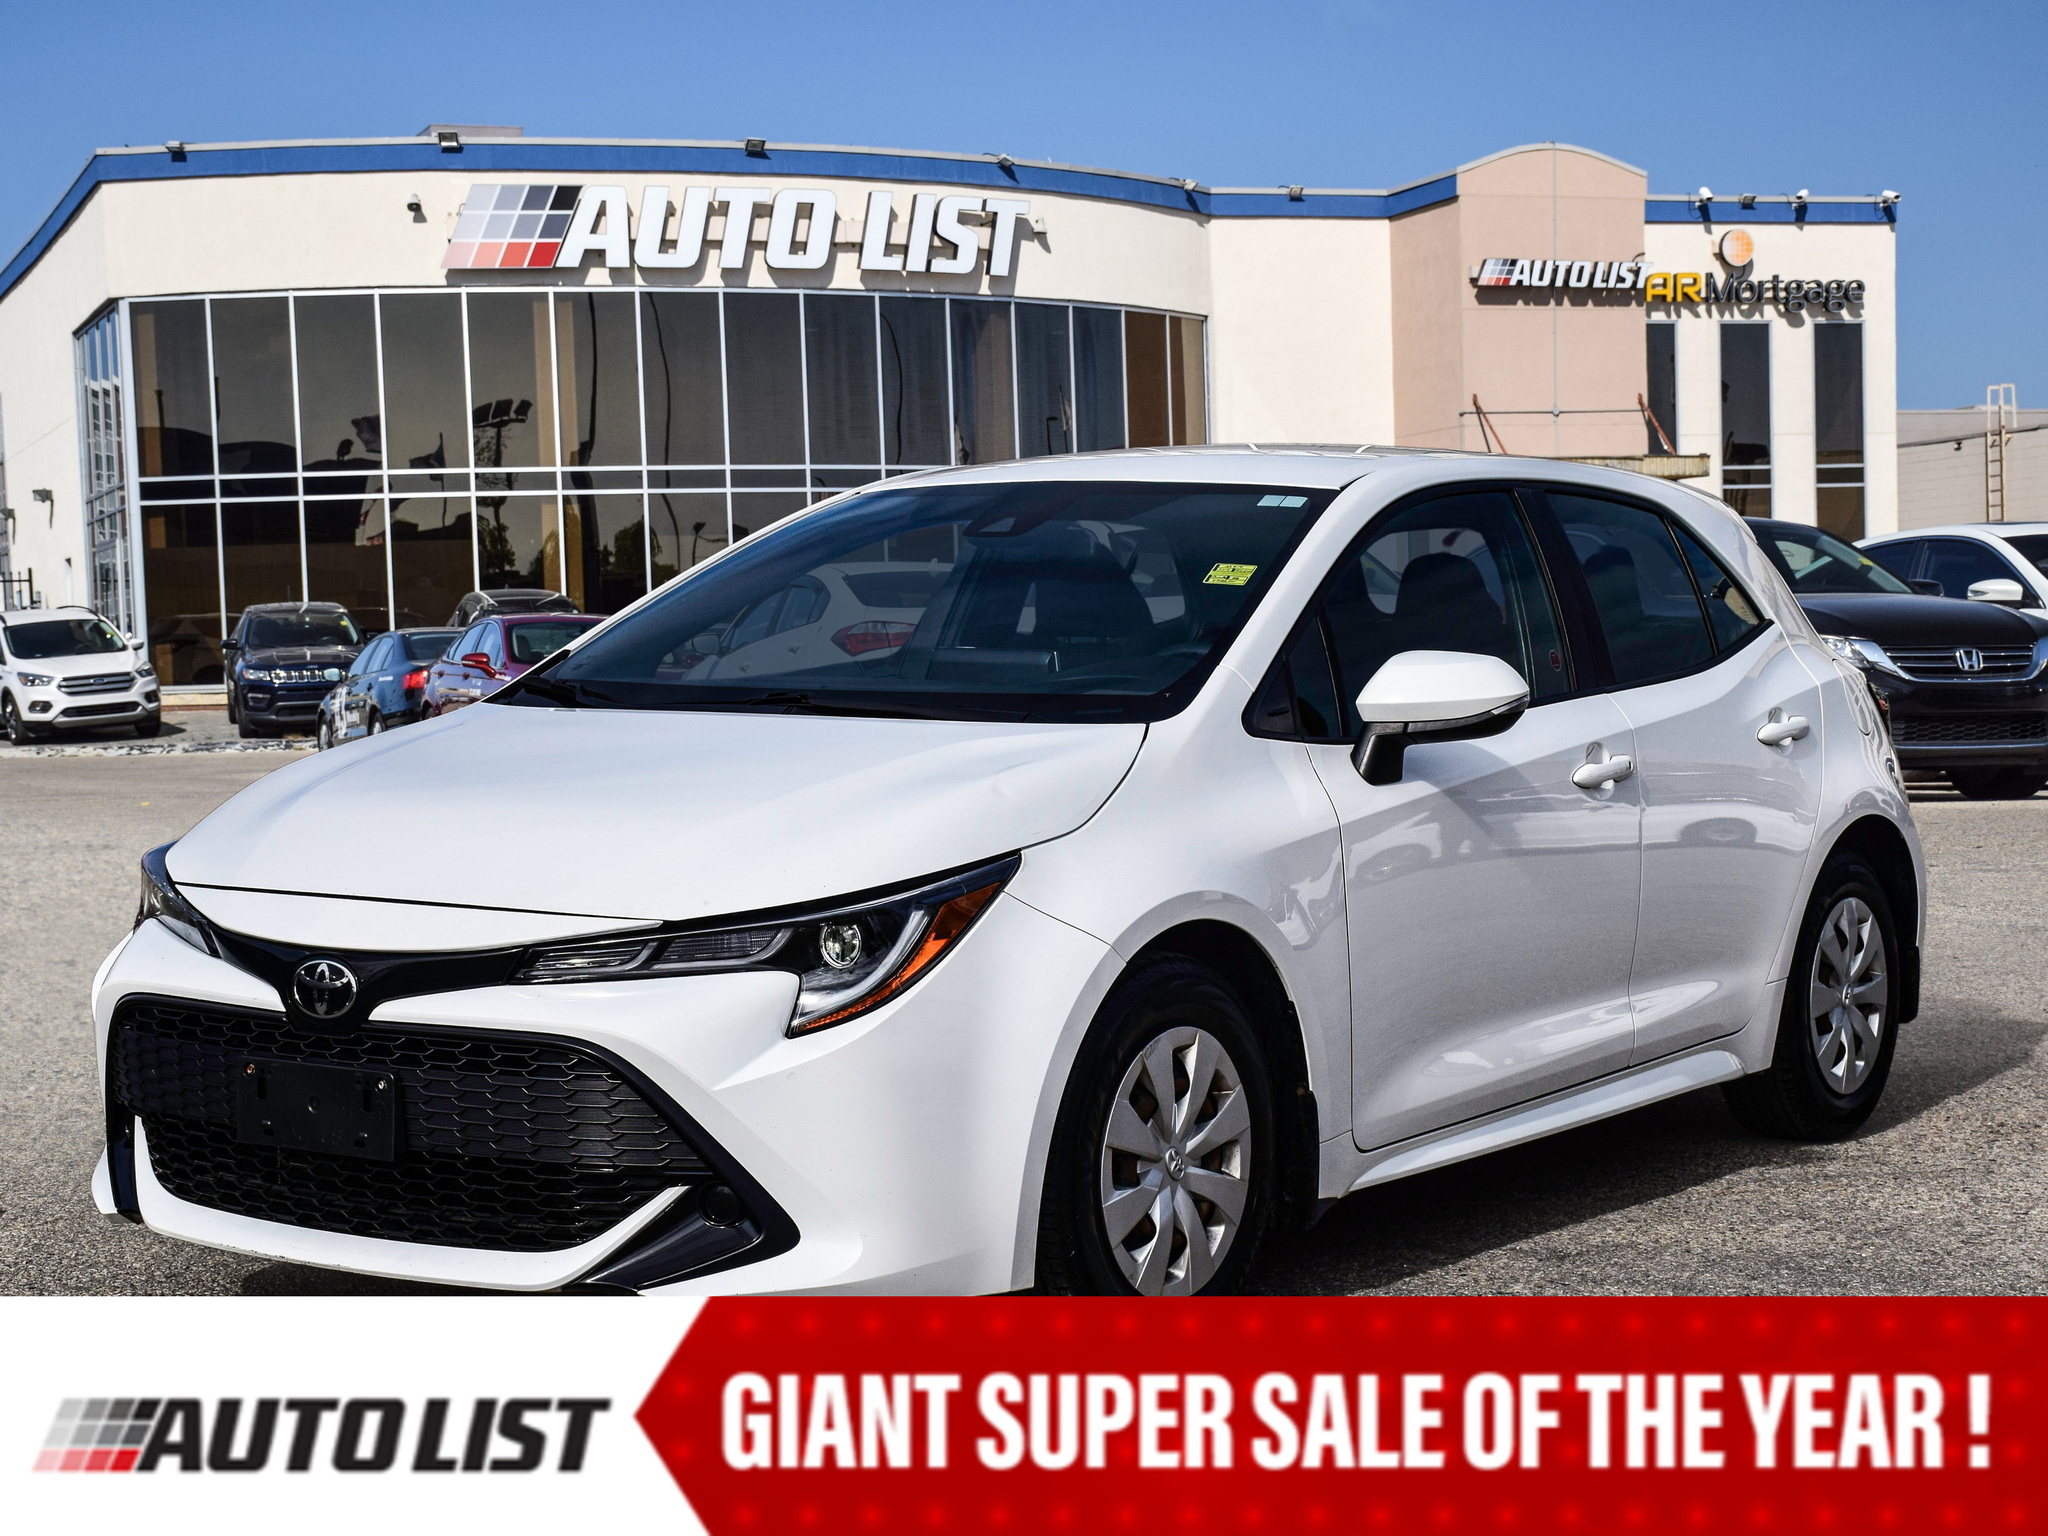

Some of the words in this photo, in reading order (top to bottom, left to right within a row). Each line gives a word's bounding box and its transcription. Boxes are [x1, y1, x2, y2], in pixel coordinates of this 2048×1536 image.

[554, 184, 838, 270] AUTO
[859, 190, 1032, 277] LIST
[1508, 258, 1593, 288] AUTO
[1591, 260, 1654, 289] LIST
[1704, 271, 1866, 313] Mortgage
